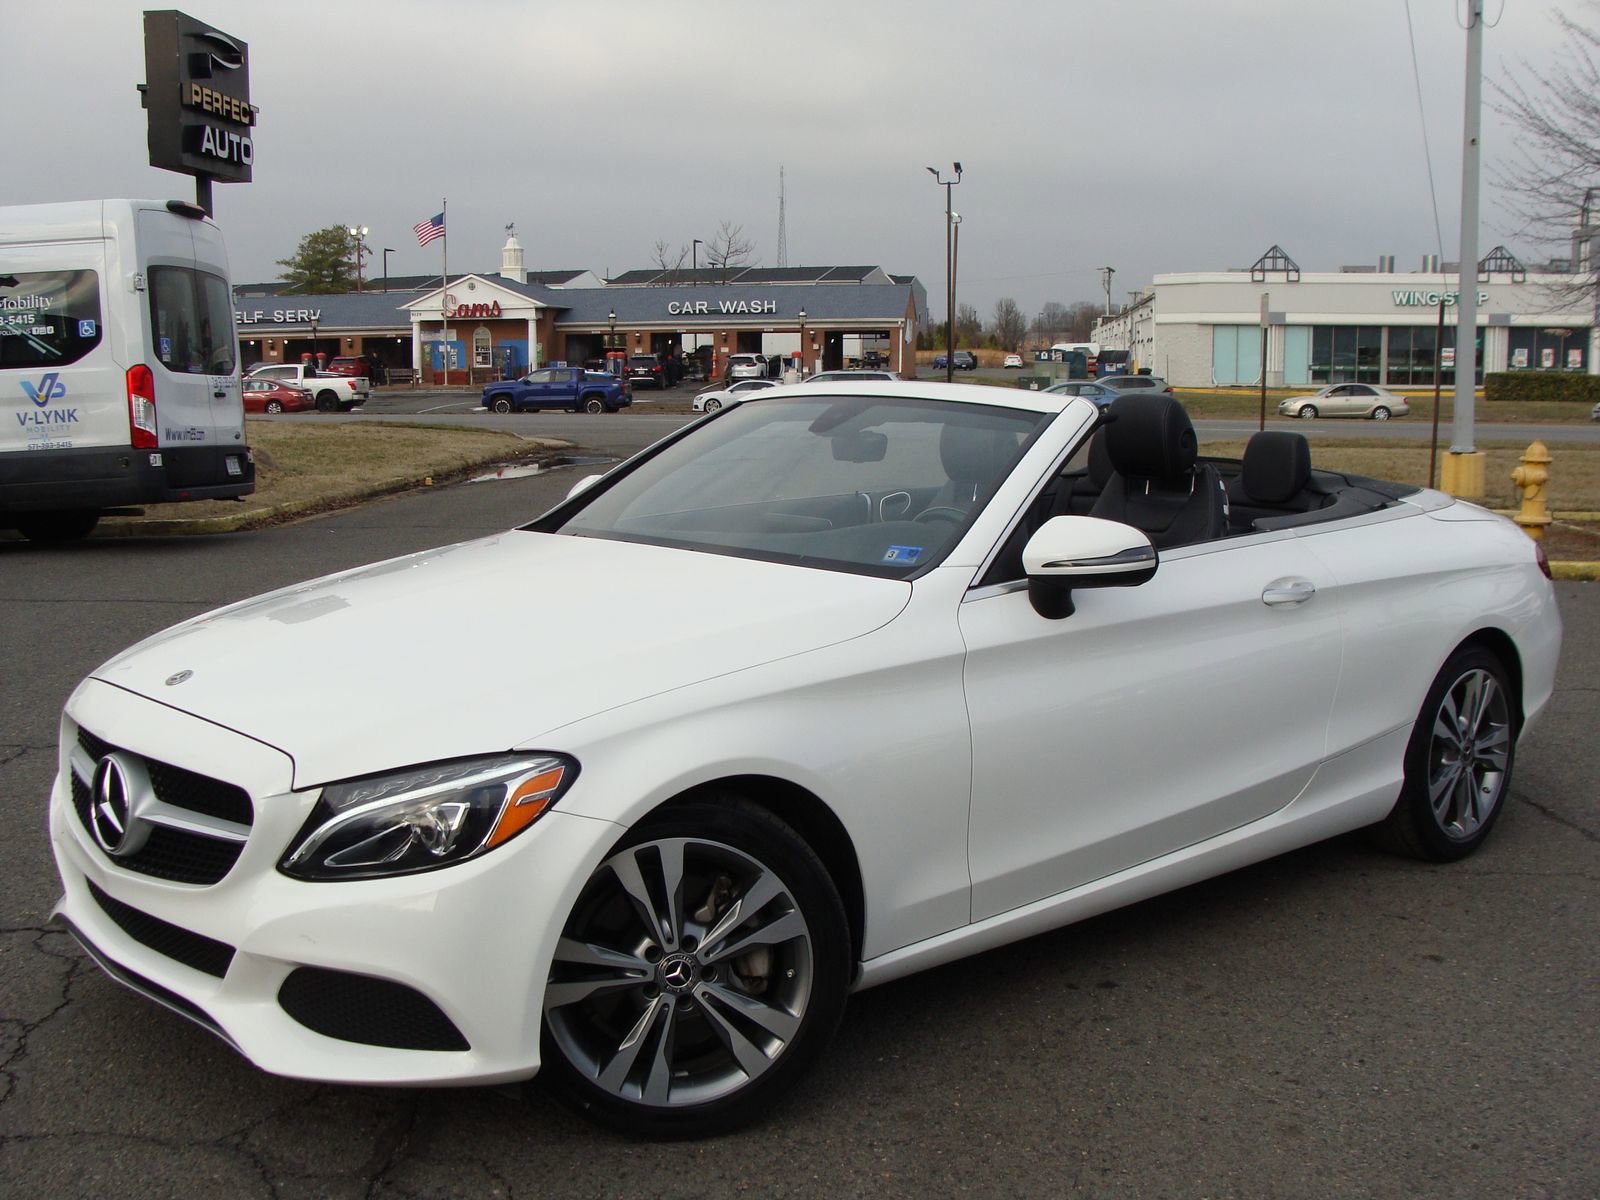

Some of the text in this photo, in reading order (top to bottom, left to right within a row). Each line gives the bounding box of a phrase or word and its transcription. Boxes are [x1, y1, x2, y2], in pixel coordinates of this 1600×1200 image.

[191, 83, 259, 126] PERFECT
[202, 125, 254, 165] AUTO
[236, 309, 321, 323] ELF SERV
[441, 293, 503, 318] Sams
[668, 300, 776, 314] CAR WASH
[16, 409, 79, 426] V-LYNK
